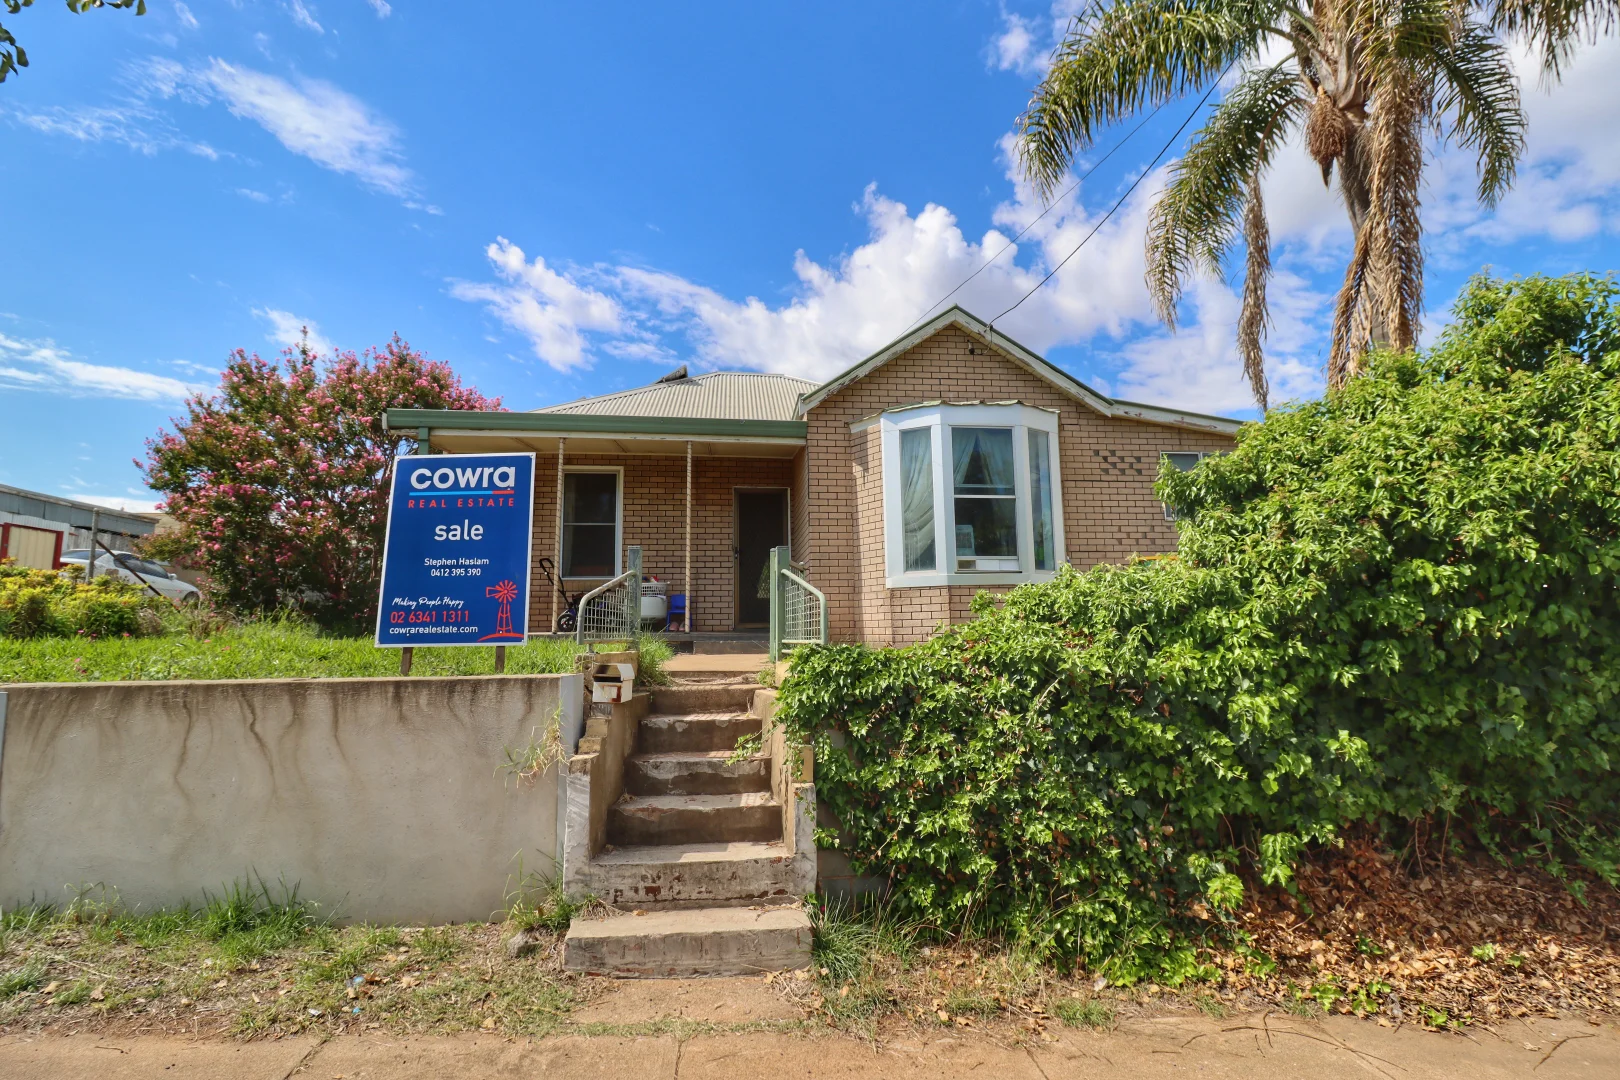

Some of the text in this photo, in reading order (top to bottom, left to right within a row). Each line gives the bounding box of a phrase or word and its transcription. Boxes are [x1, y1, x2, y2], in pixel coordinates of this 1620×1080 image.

[410, 466, 516, 489] cowra
[408, 498, 514, 508] REAL ESTATE
[434, 519, 484, 540] sale
[424, 557, 490, 567] Stephen Haslam
[430, 568, 481, 577] 0412 395 390
[392, 596, 465, 609] Making People Happy
[390, 610, 469, 624] 02 6341 1311
[389, 625, 479, 634] cowrarealestate.com
